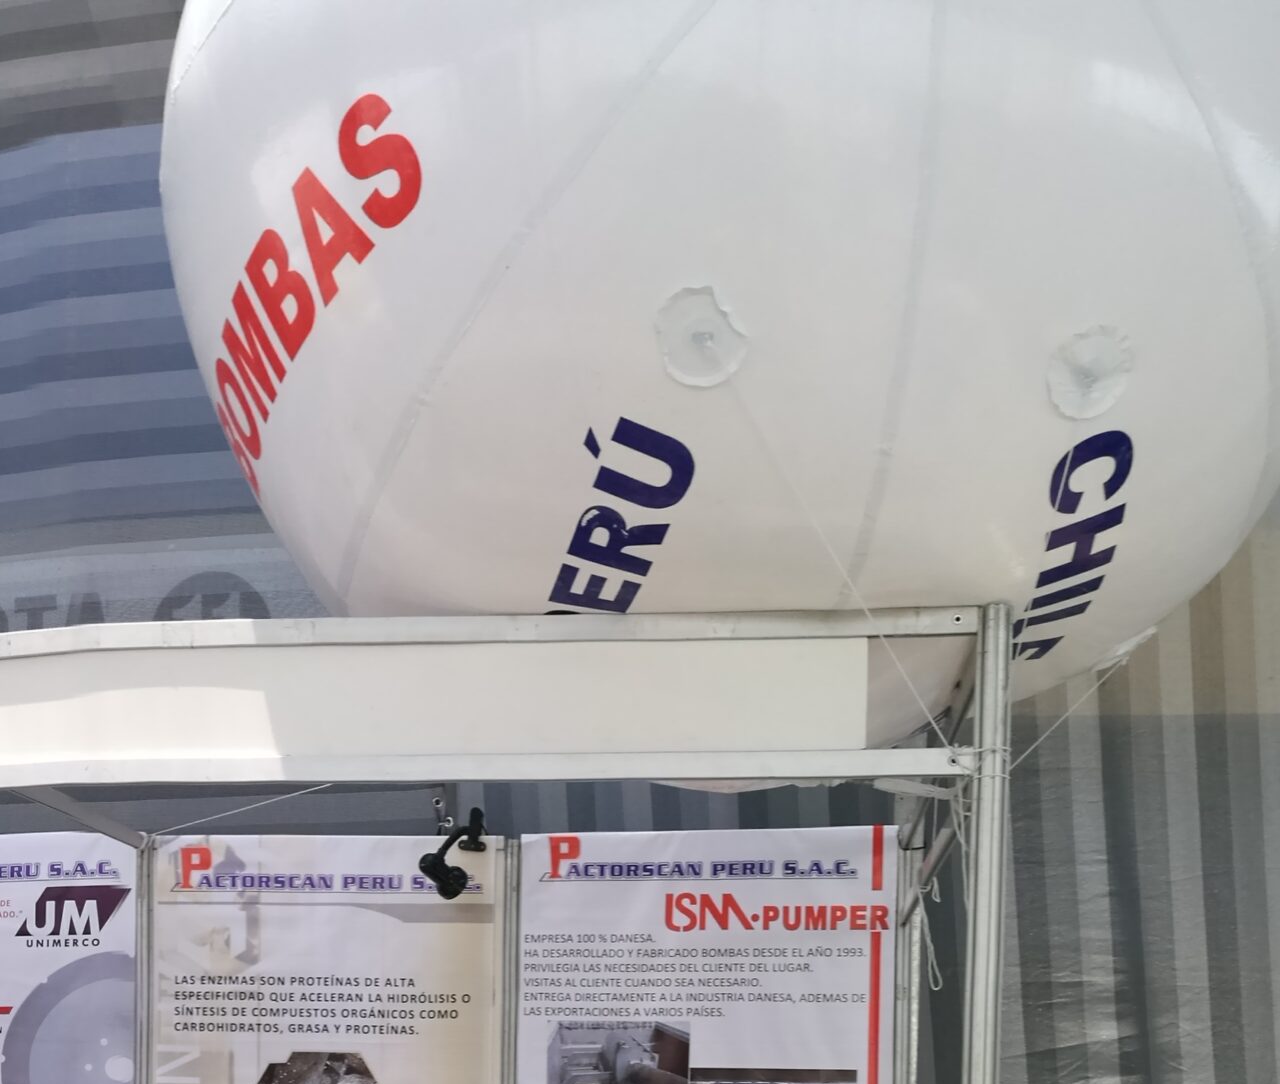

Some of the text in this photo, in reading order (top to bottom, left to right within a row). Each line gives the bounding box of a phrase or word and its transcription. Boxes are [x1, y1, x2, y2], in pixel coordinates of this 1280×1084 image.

[544, 416, 695, 614] ERÚ
[549, 835, 857, 879] PACTORSCAN PERU S.A.C.
[48, 860, 118, 877] S.A.C.
[179, 845, 402, 891] PACTORSCAN PERU
[26, 938, 101, 948] UNIMERCO
[524, 933, 656, 944] EMPRESA 100 % DANESA.
[524, 963, 814, 973] PRIVILEGIA LAS NECESIDADES DEL CLIENTE DEL LUGAR.
[174, 974, 415, 987] LAS ENZIMAS SON PROTEÍNAS DE ALTA
[174, 1022, 420, 1035] CARBOHIDRATOS, GRASA Y PROTEÍNAS.
